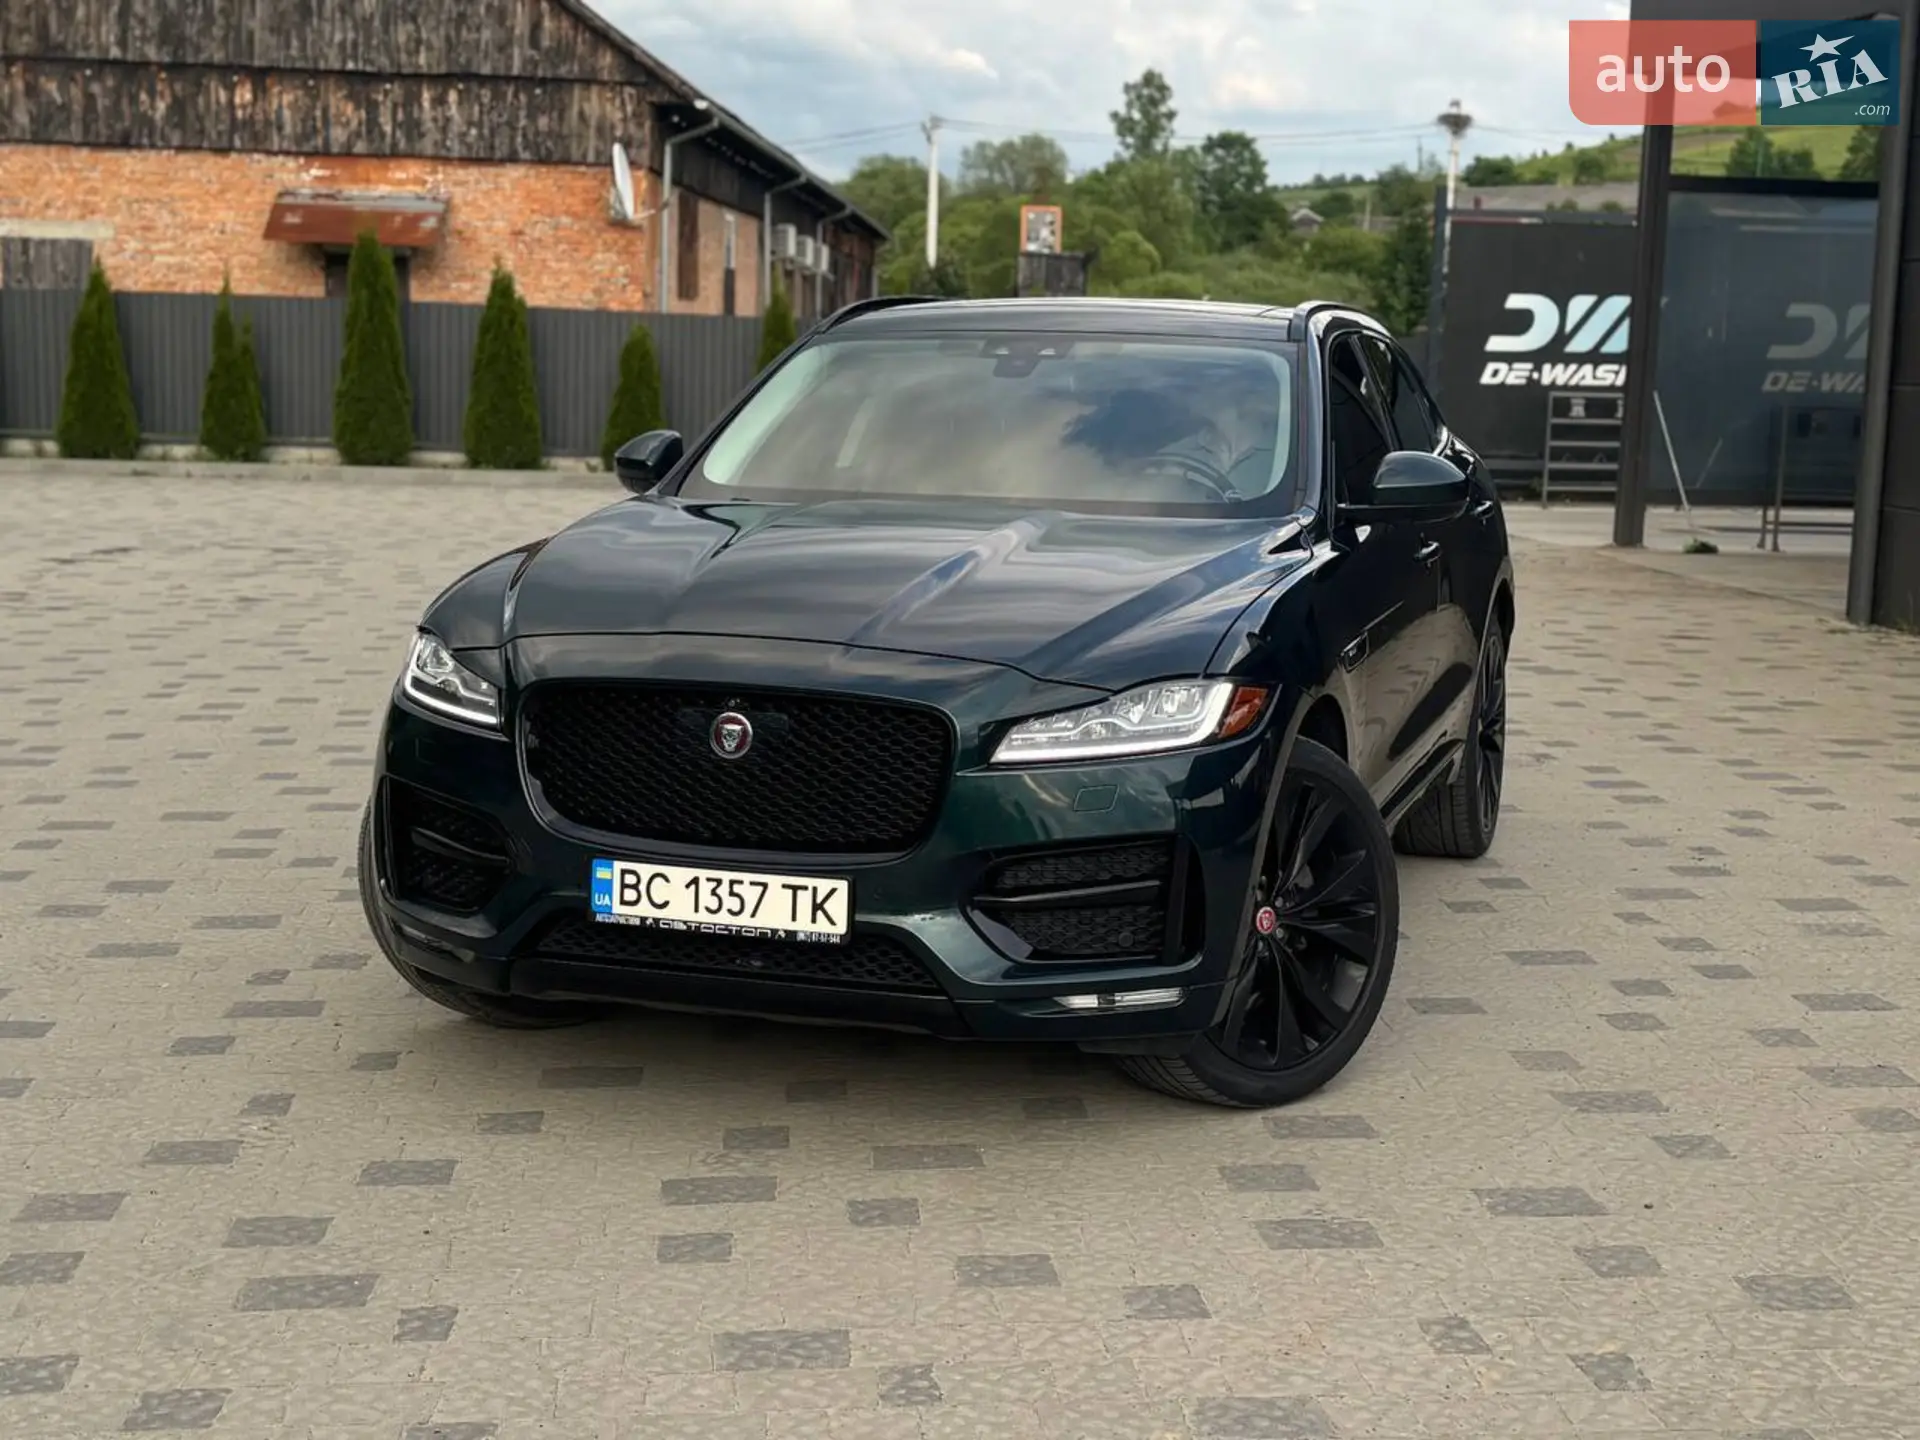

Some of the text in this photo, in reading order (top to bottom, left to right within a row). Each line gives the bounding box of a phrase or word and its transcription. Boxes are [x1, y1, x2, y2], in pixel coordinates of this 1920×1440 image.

[594, 893, 611, 907] UA
[619, 868, 838, 926] BC 1357 TK
